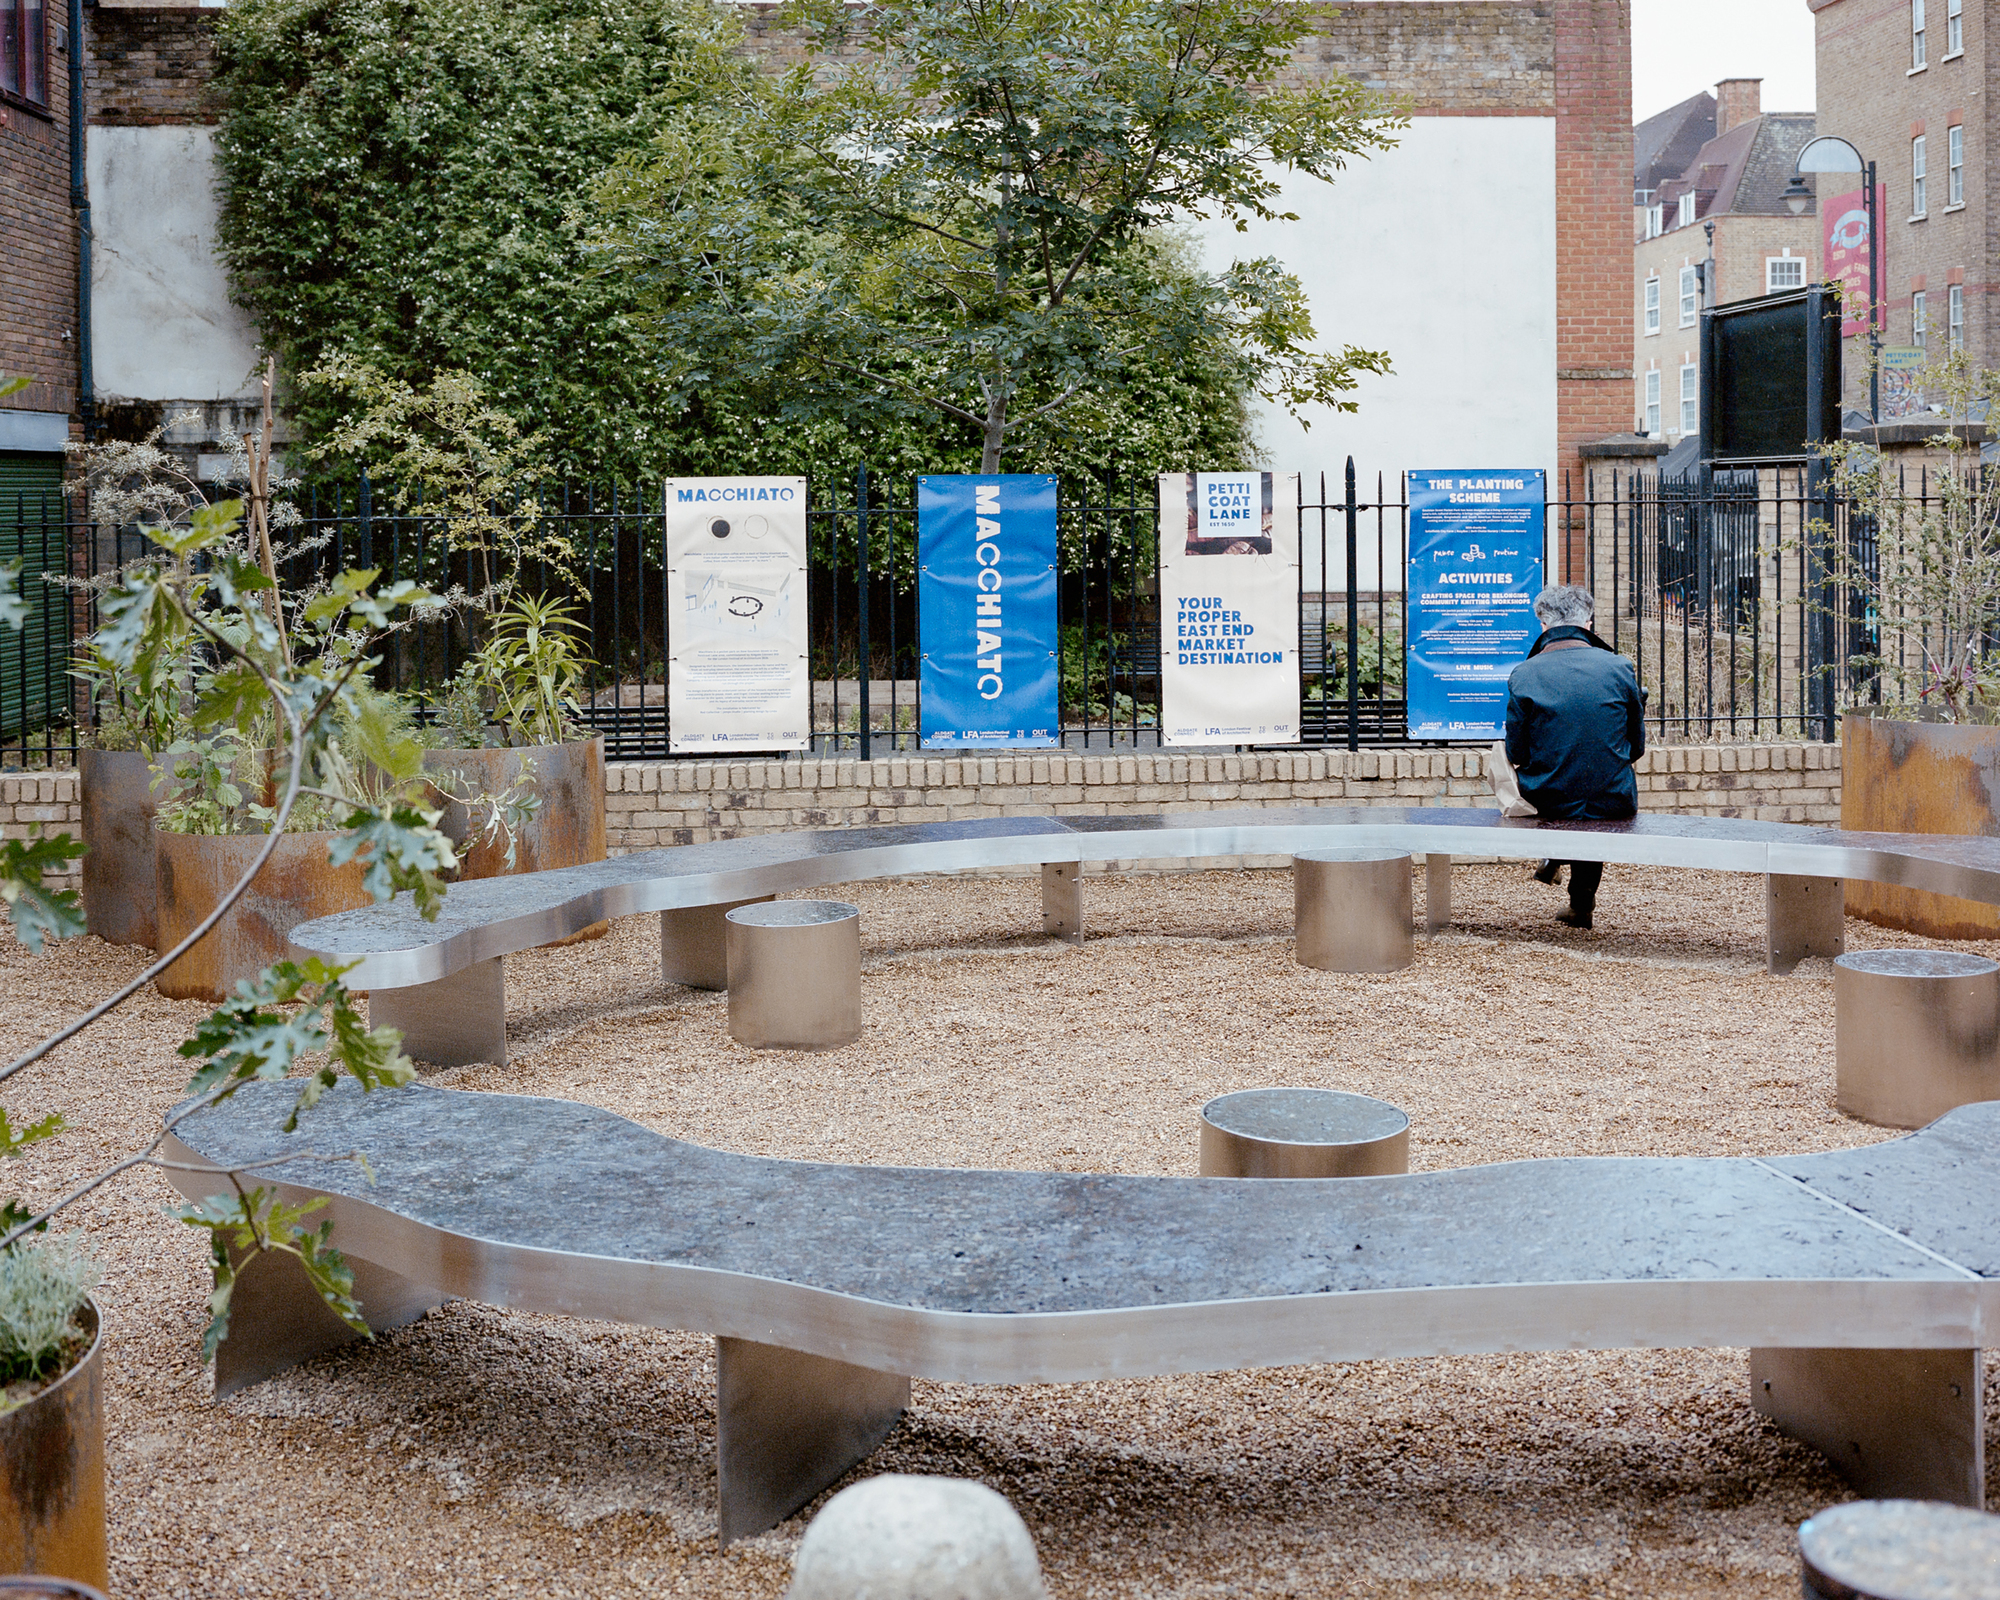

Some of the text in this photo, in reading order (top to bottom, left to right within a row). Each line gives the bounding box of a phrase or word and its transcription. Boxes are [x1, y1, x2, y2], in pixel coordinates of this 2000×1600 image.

[1208, 483, 1250, 495] PETTI
[1428, 479, 1524, 490] THE PLANTING
[677, 487, 794, 502] MACCHIATO
[1449, 492, 1500, 503] SCHEME
[1208, 496, 1251, 508] COAT
[1209, 509, 1251, 520] LANE
[1433, 550, 1454, 562] pause
[1439, 573, 1513, 584] ACTIVITIES
[975, 485, 1003, 700] MACCHIATO
[1177, 597, 1223, 609] YOUR
[1177, 610, 1242, 623] PROPER
[1178, 624, 1254, 637] EAST END
[1178, 638, 1245, 651] MARKET
[1178, 651, 1282, 665] DESTINATION
[1449, 722, 1465, 730] LFA
[962, 731, 979, 739] LFA
